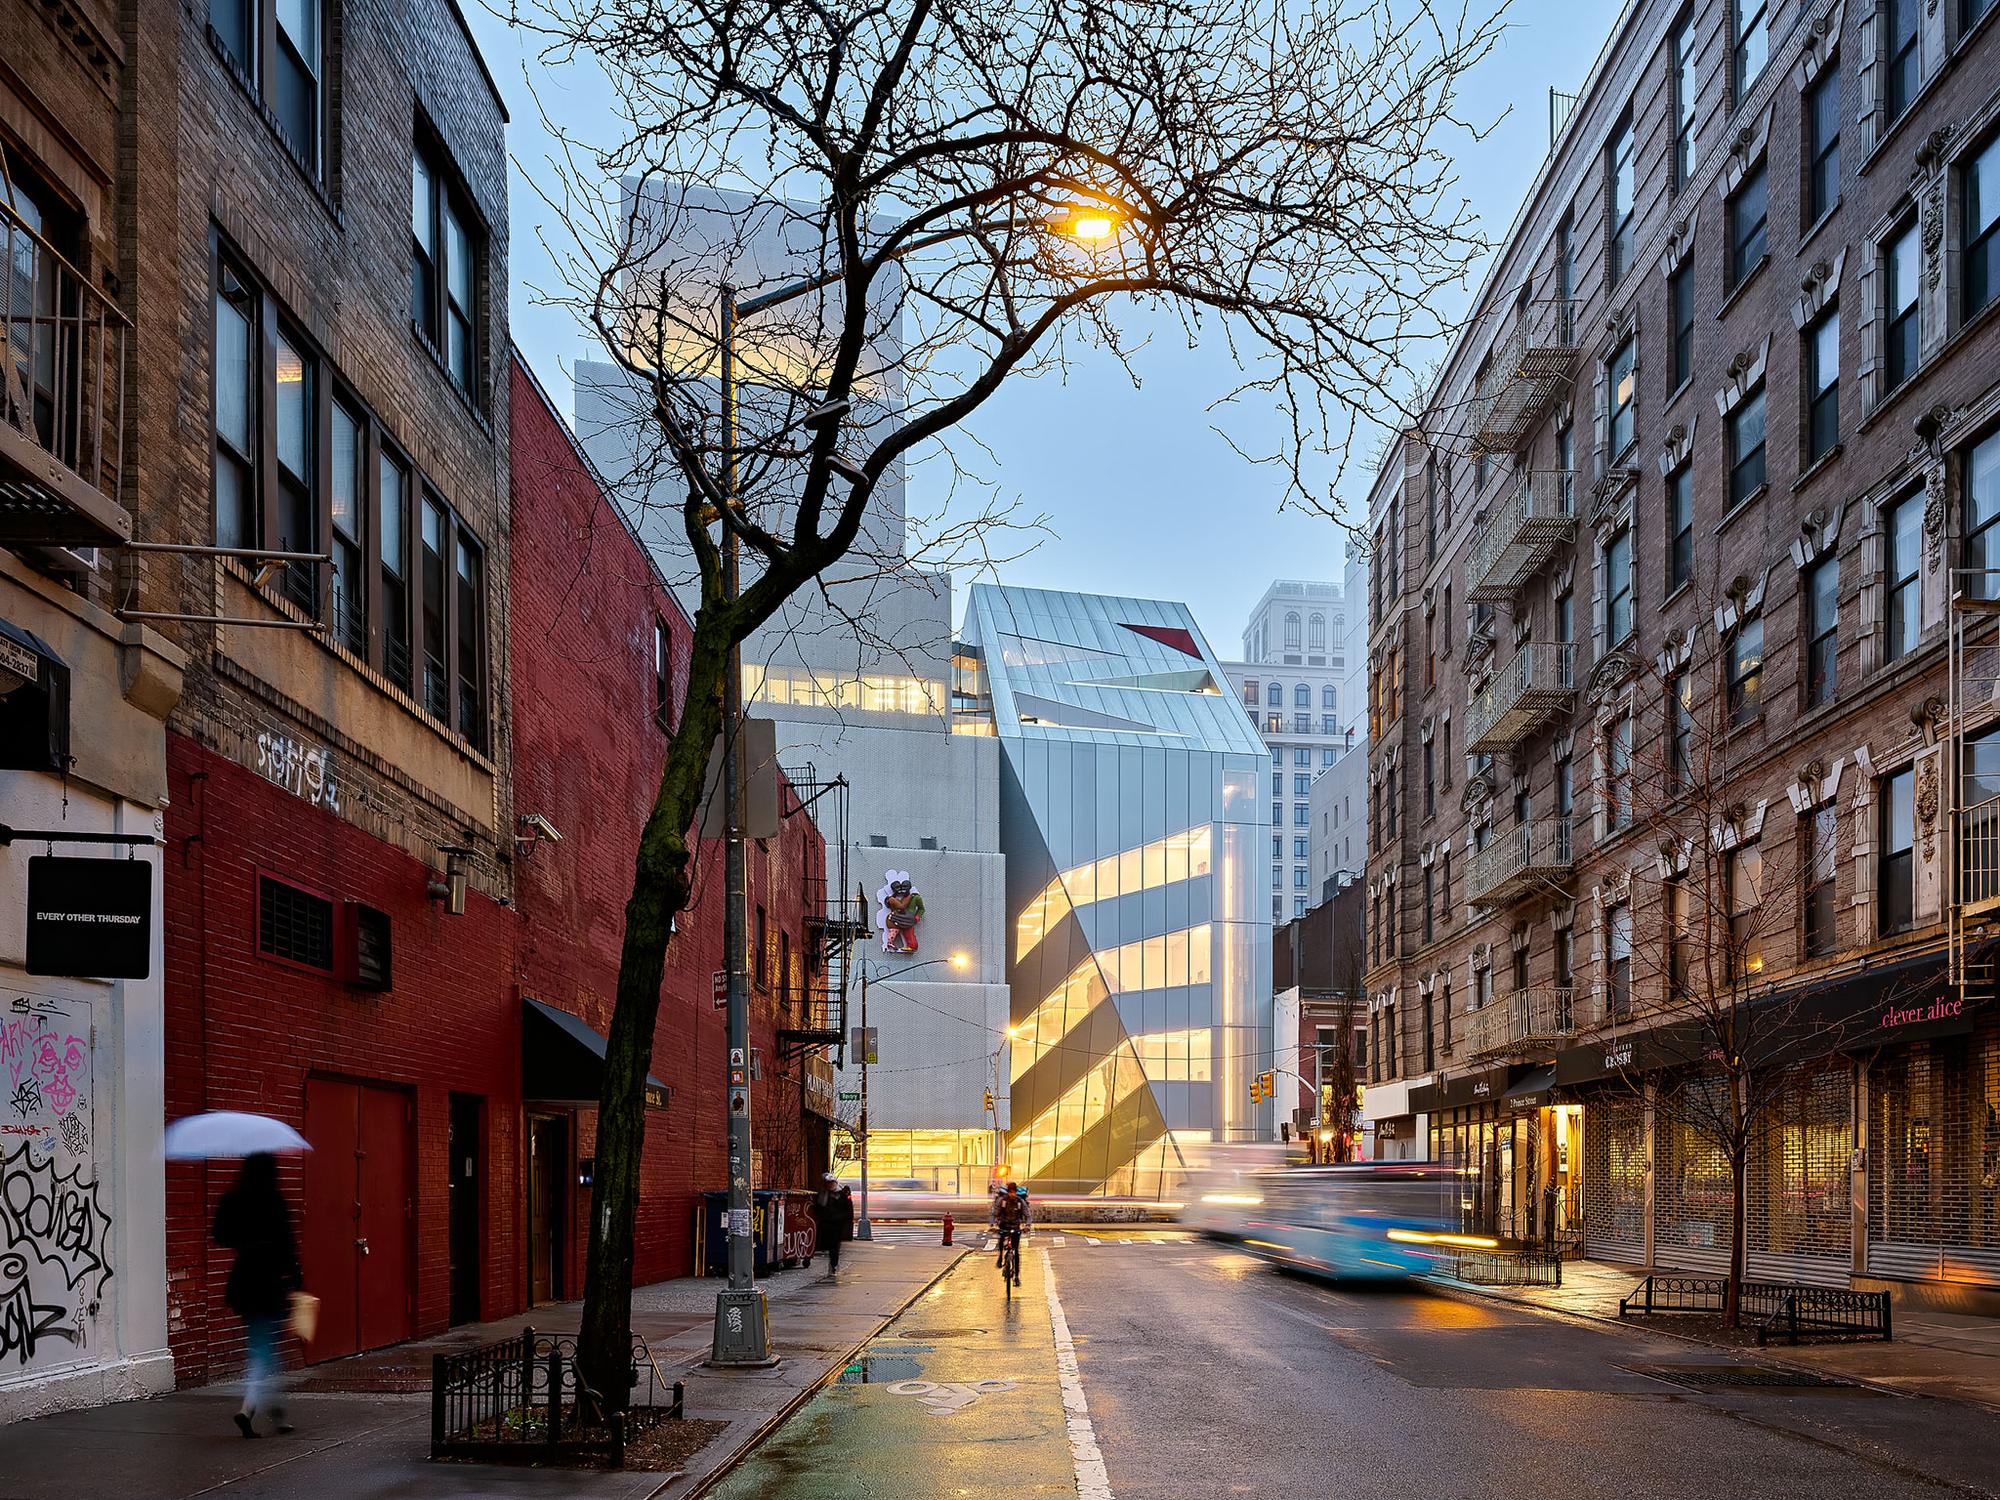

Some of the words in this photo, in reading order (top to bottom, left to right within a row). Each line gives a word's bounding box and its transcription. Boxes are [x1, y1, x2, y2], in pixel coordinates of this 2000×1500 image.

[36, 912, 65, 921] EVERY
[66, 913, 95, 922] OTHER
[97, 915, 141, 924] THURSDAY
[1882, 1006, 1923, 1028] clever
[1927, 996, 1962, 1020] alice
[1513, 1099, 1525, 1107] Prince
[1525, 1096, 1537, 1105] Street
